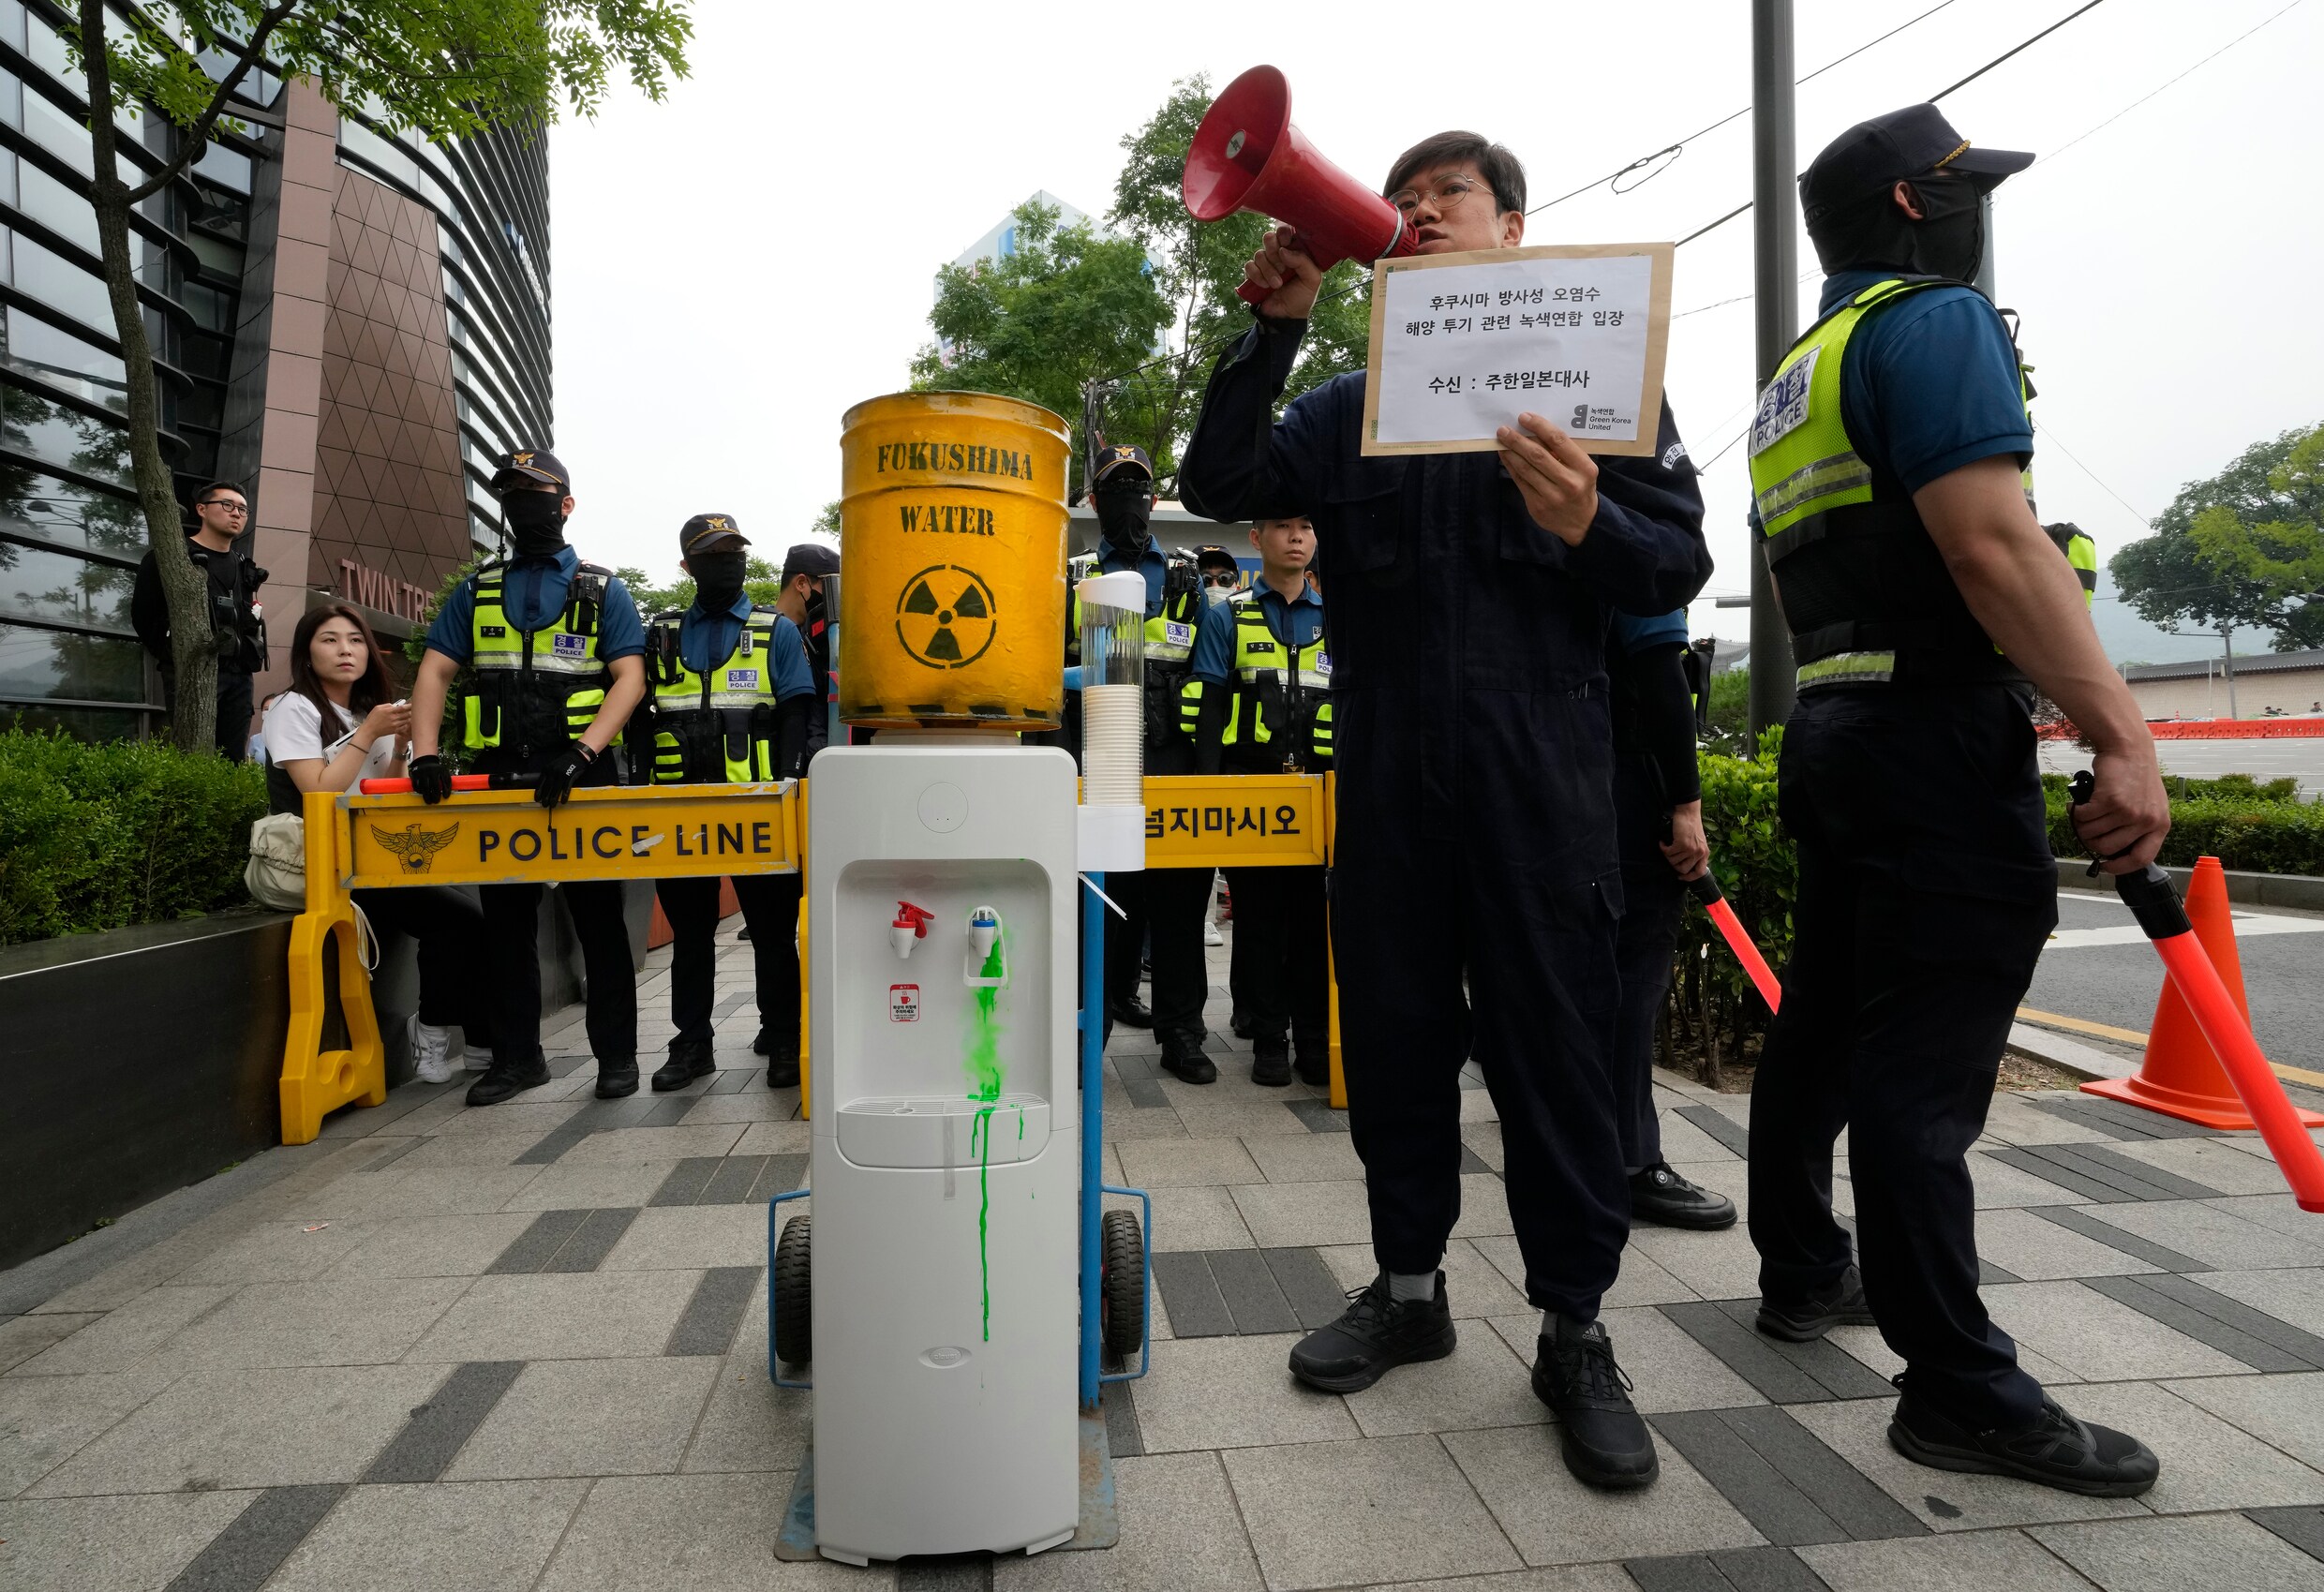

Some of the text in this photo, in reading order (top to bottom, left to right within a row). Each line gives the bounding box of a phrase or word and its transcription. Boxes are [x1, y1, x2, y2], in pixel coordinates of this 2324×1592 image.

[1429, 287, 1601, 311] 후쿠시마 방사성 오염수
[1406, 310, 1625, 336] 해양 투기 관련 녹색연합 입장
[1428, 376, 1462, 394] 수신
[1485, 370, 1590, 391] 주한일본대사
[1590, 408, 1616, 416] 녹색연합
[1756, 401, 1801, 448] POLICE
[877, 442, 1034, 481] FUKUSHIMA
[1664, 446, 1680, 466] 안전
[900, 505, 995, 536] WATER
[340, 558, 397, 616] TWIN
[1169, 635, 1188, 644] POLICE
[479, 822, 771, 862] POLICE LINE
[1582, 1333, 1602, 1343] adidas
